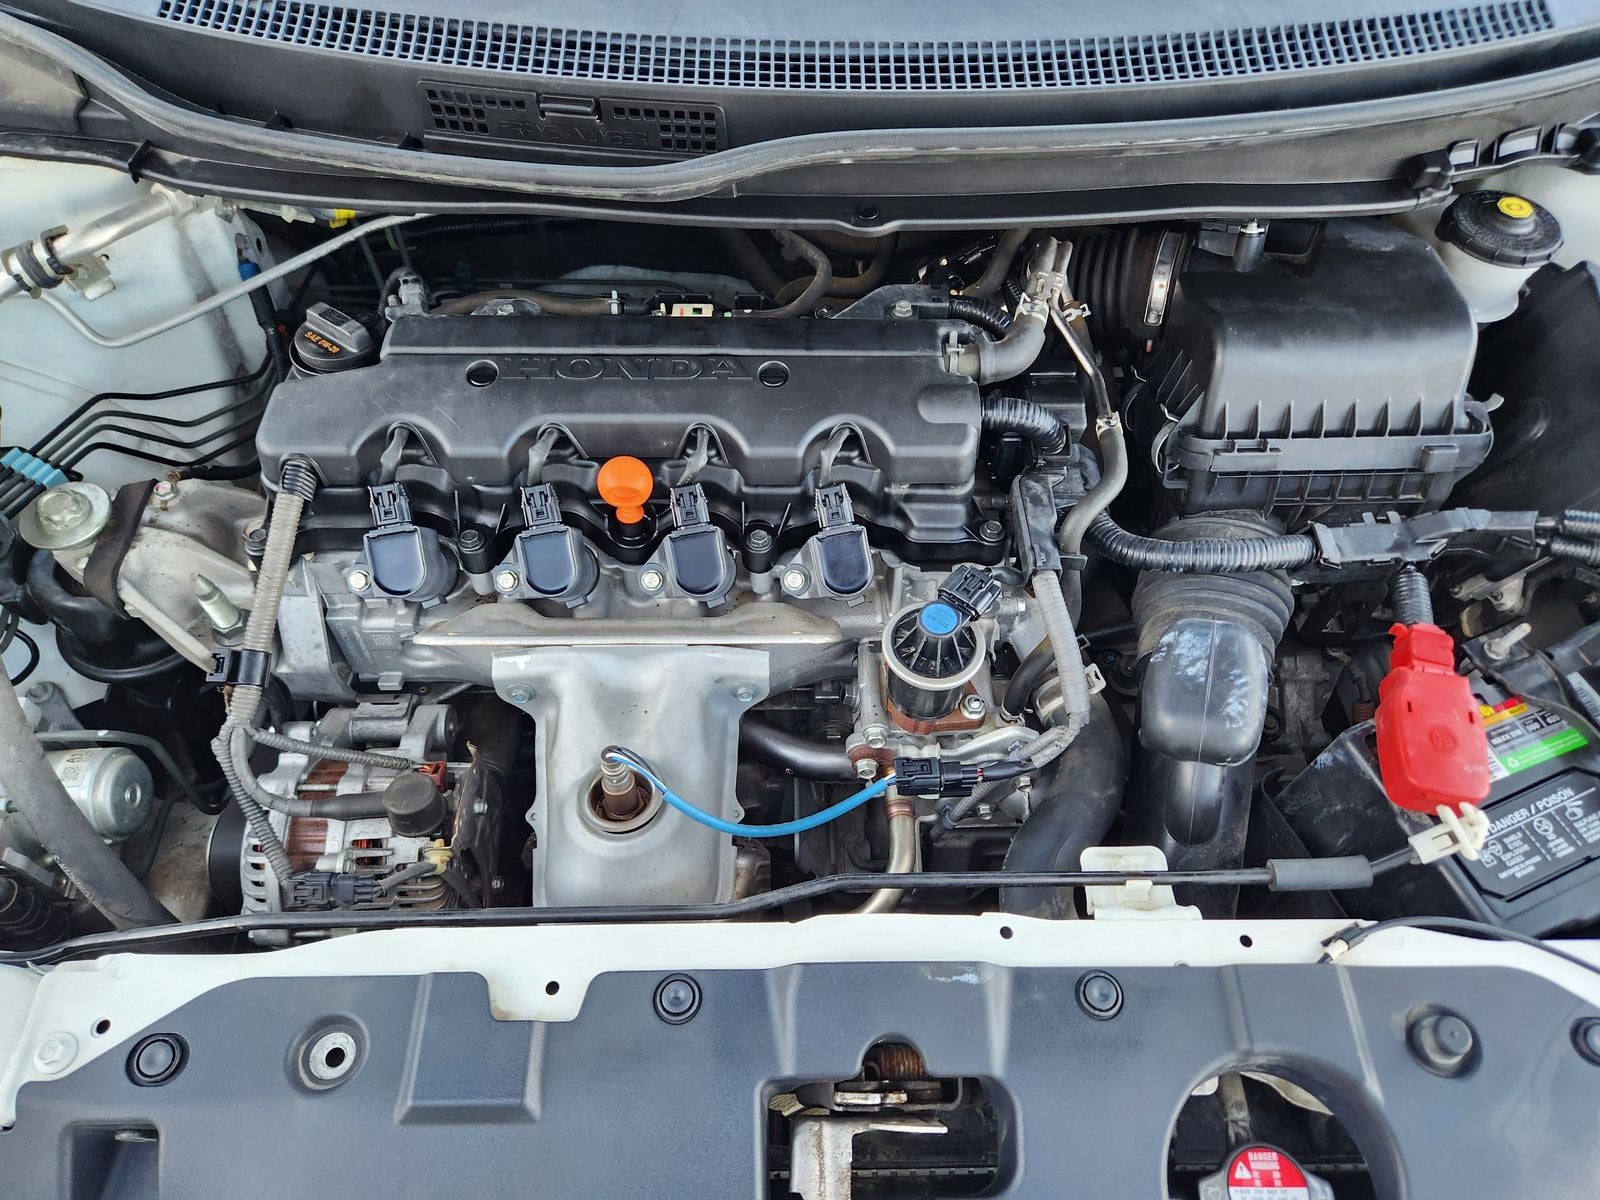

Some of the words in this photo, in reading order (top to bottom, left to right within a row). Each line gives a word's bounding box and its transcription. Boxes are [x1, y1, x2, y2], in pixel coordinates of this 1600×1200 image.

[498, 119, 561, 140] FRAME
[573, 126, 648, 147] NUMBER
[304, 331, 321, 343] SAE
[318, 339, 340, 354] 0W-20
[500, 357, 754, 380] HONDA
[1488, 808, 1531, 834] DANGER
[1535, 787, 1576, 811] POISON
[1247, 1151, 1279, 1161] DANGER
